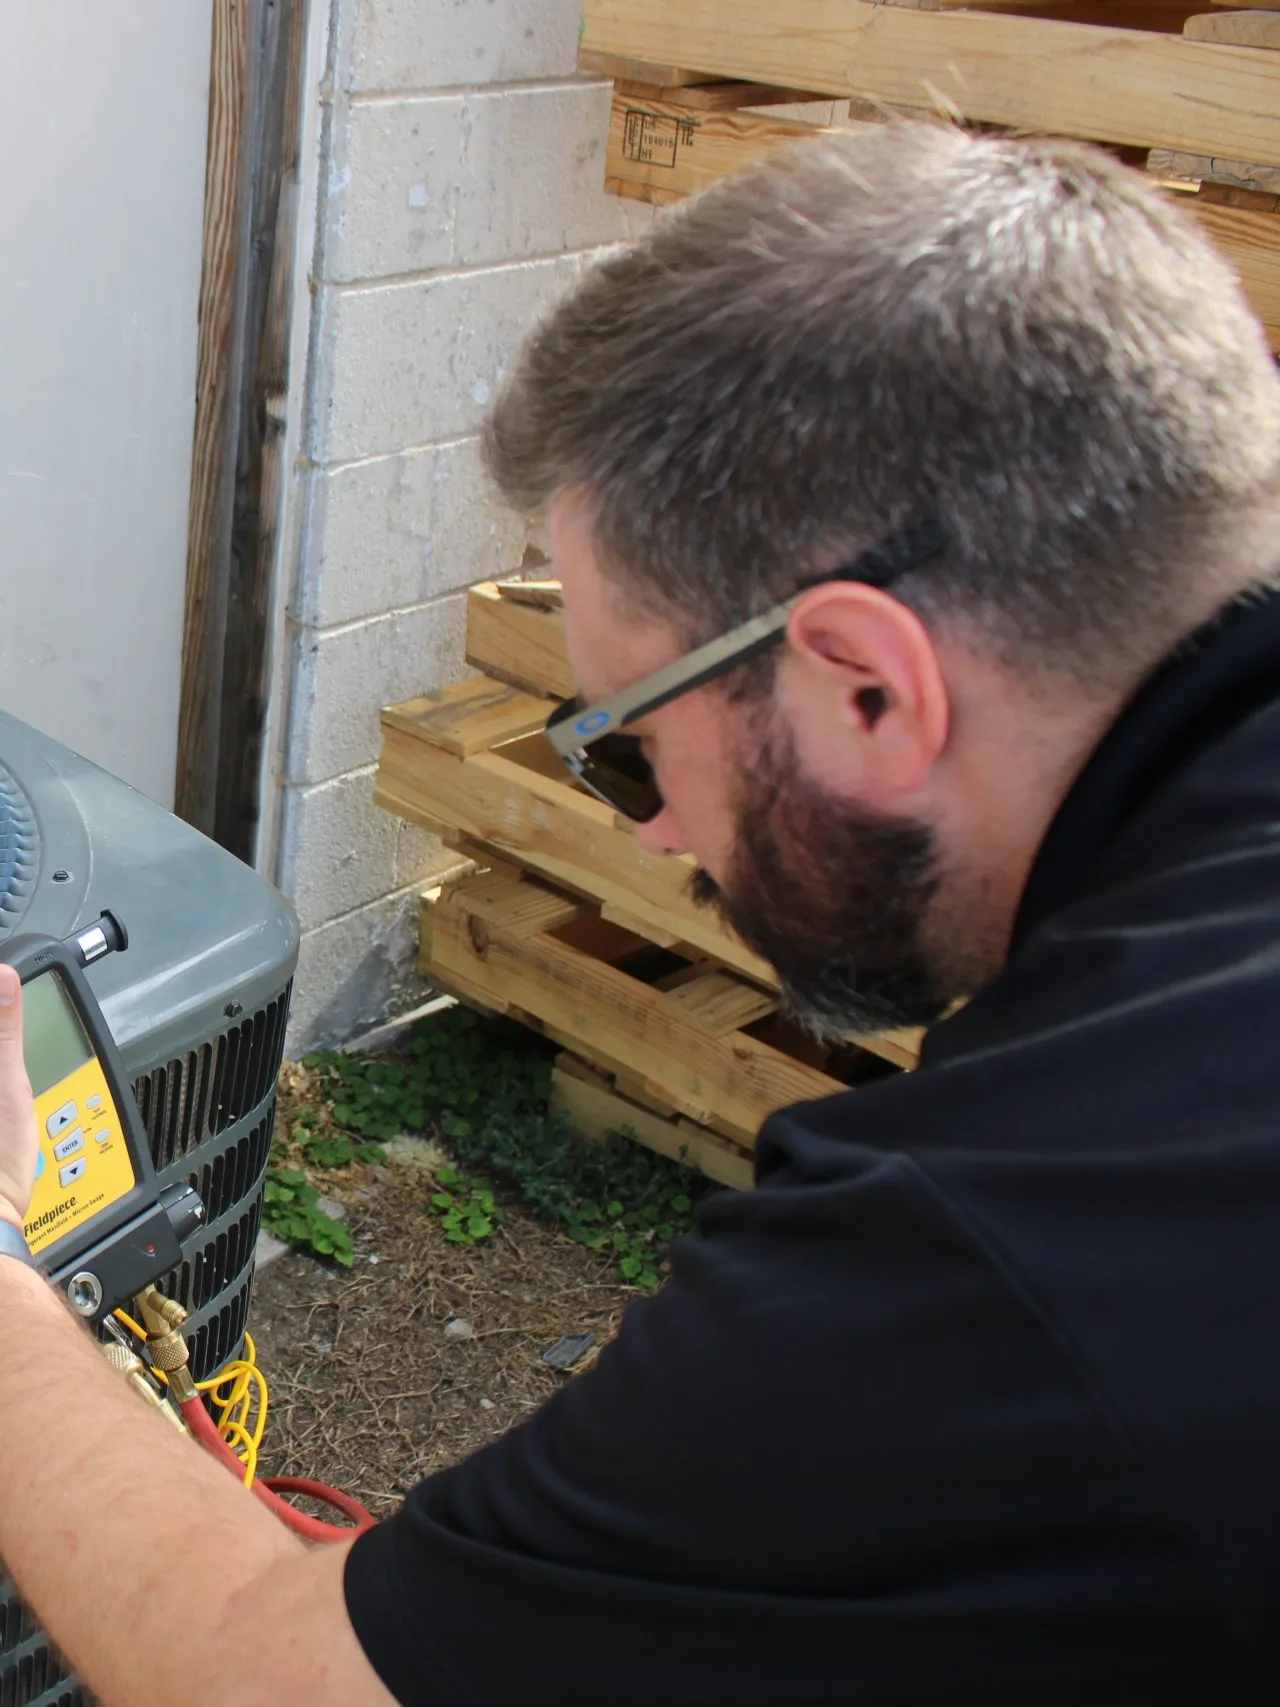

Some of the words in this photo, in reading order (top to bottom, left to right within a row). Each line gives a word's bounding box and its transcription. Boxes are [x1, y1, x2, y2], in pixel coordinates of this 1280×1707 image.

[62, 1140, 79, 1154] ENTER
[24, 1196, 77, 1238] Fieldpiece
[46, 1216, 69, 1234] Manifold
[72, 1204, 89, 1217] Micron
